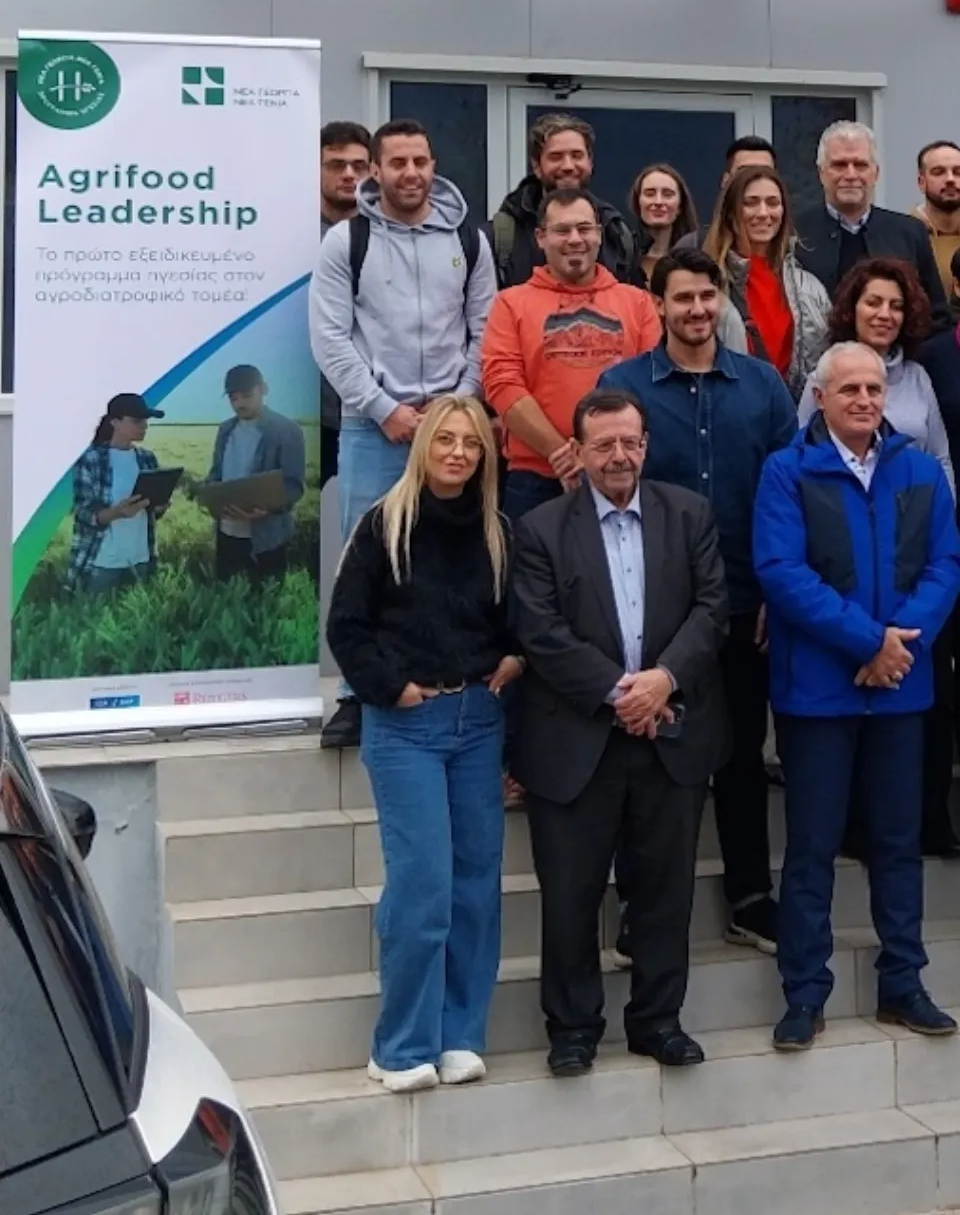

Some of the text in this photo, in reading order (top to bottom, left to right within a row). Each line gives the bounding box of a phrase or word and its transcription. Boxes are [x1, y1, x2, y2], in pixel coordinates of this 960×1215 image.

[37, 163, 215, 193] Agrifood
[38, 199, 258, 230] Leadership
[36, 247, 257, 264] Το πρώτο εξειδικευμένο
[34, 268, 266, 285] πρόγραμμα ηγεσίας στον
[34, 286, 186, 304] αγροδιατροφικό
